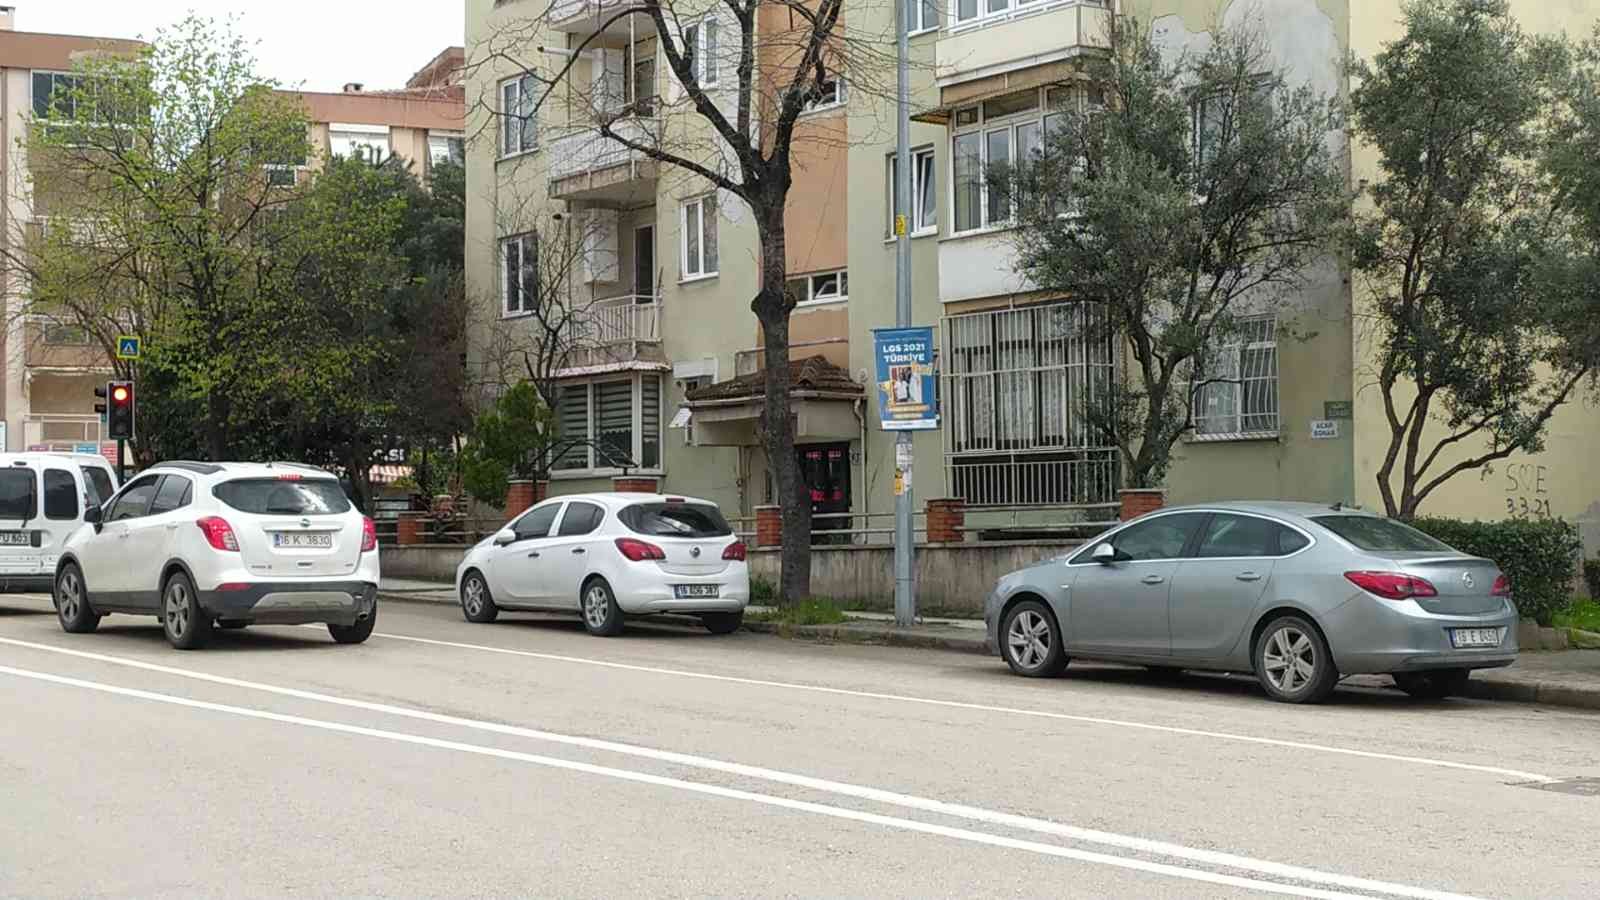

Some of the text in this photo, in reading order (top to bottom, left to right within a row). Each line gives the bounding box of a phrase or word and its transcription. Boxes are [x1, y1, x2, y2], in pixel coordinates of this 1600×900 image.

[882, 343, 925, 353] LGS 2021
[292, 535, 301, 545] K
